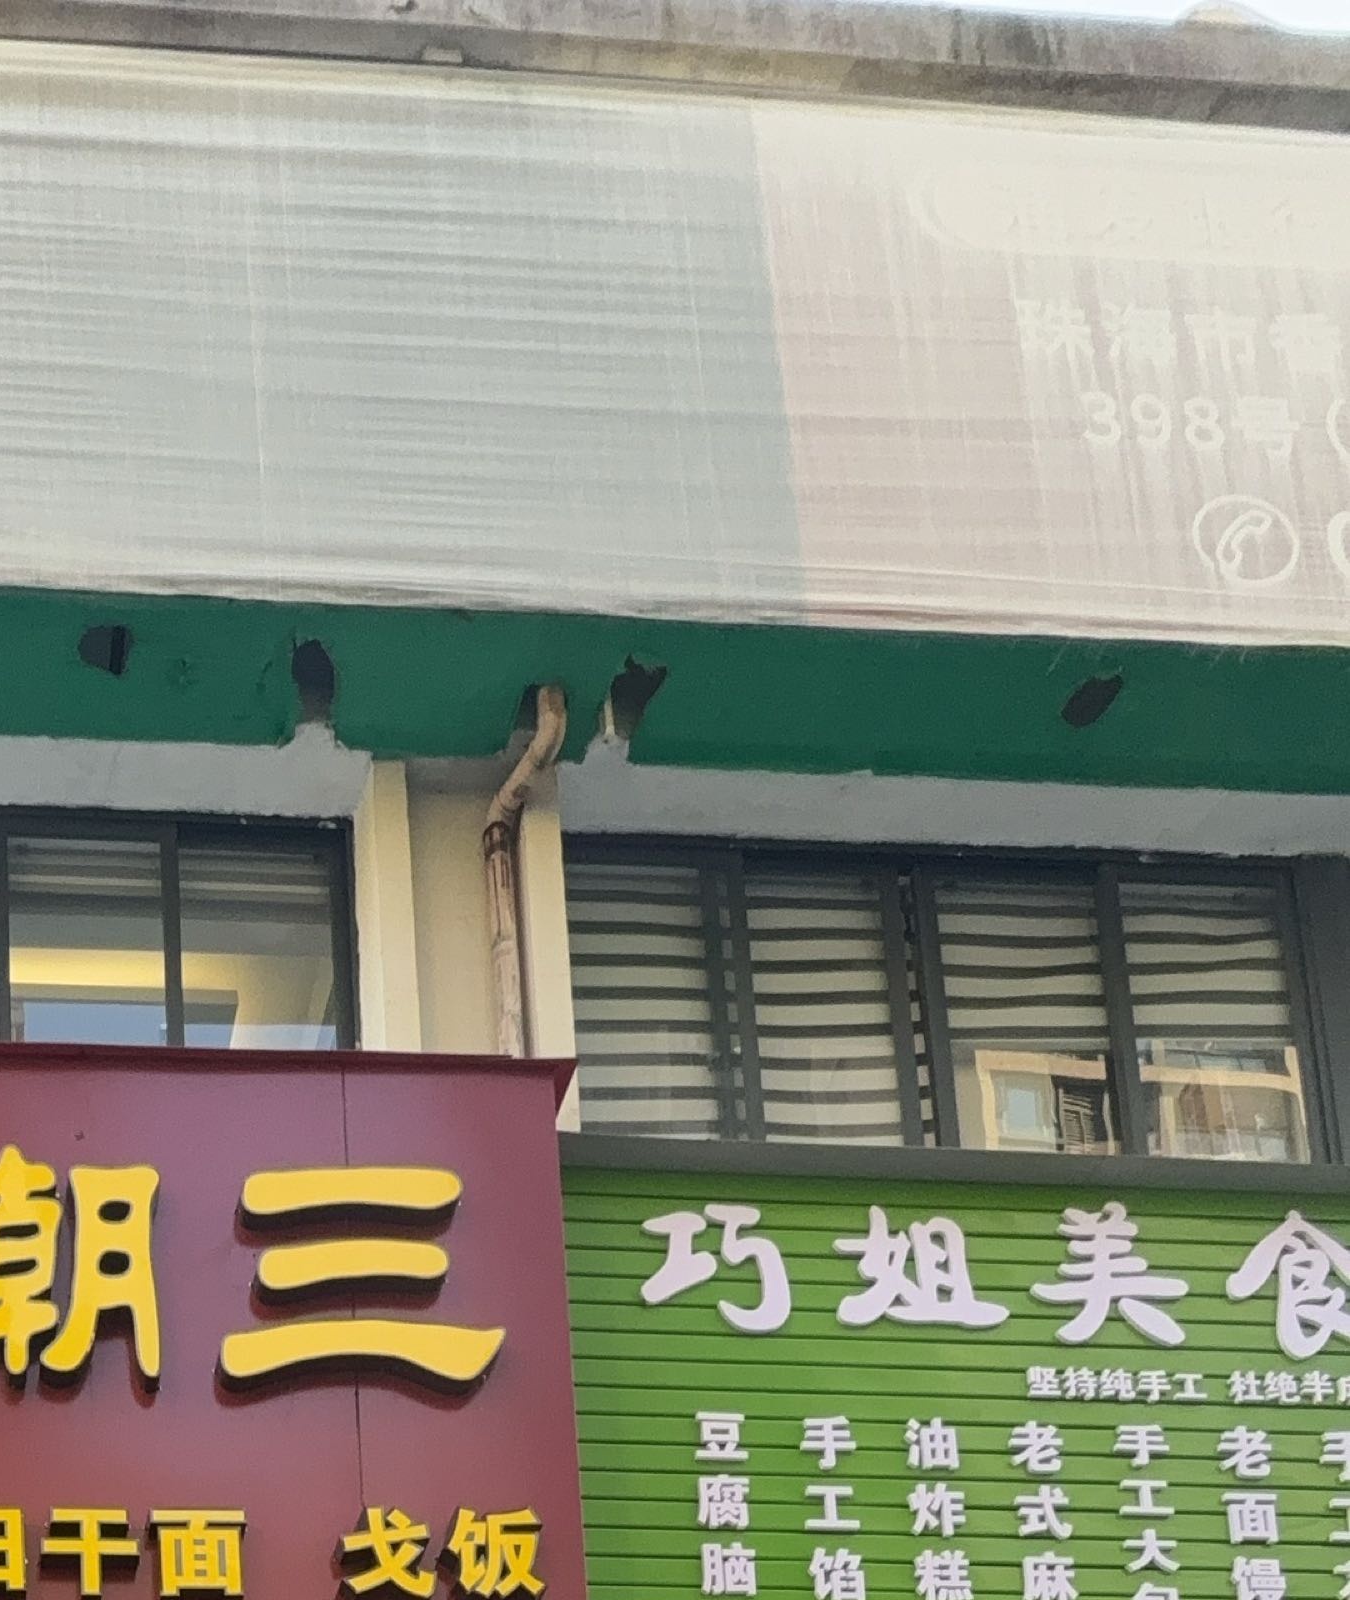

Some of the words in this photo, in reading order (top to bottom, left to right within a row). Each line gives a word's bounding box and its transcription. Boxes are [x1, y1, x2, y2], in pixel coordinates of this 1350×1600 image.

[639, 1202, 1350, 1359] 巧姐美食
[1026, 1366, 1208, 1403] 坚持纯手工
[694, 1410, 757, 1598] 豆腐脑
